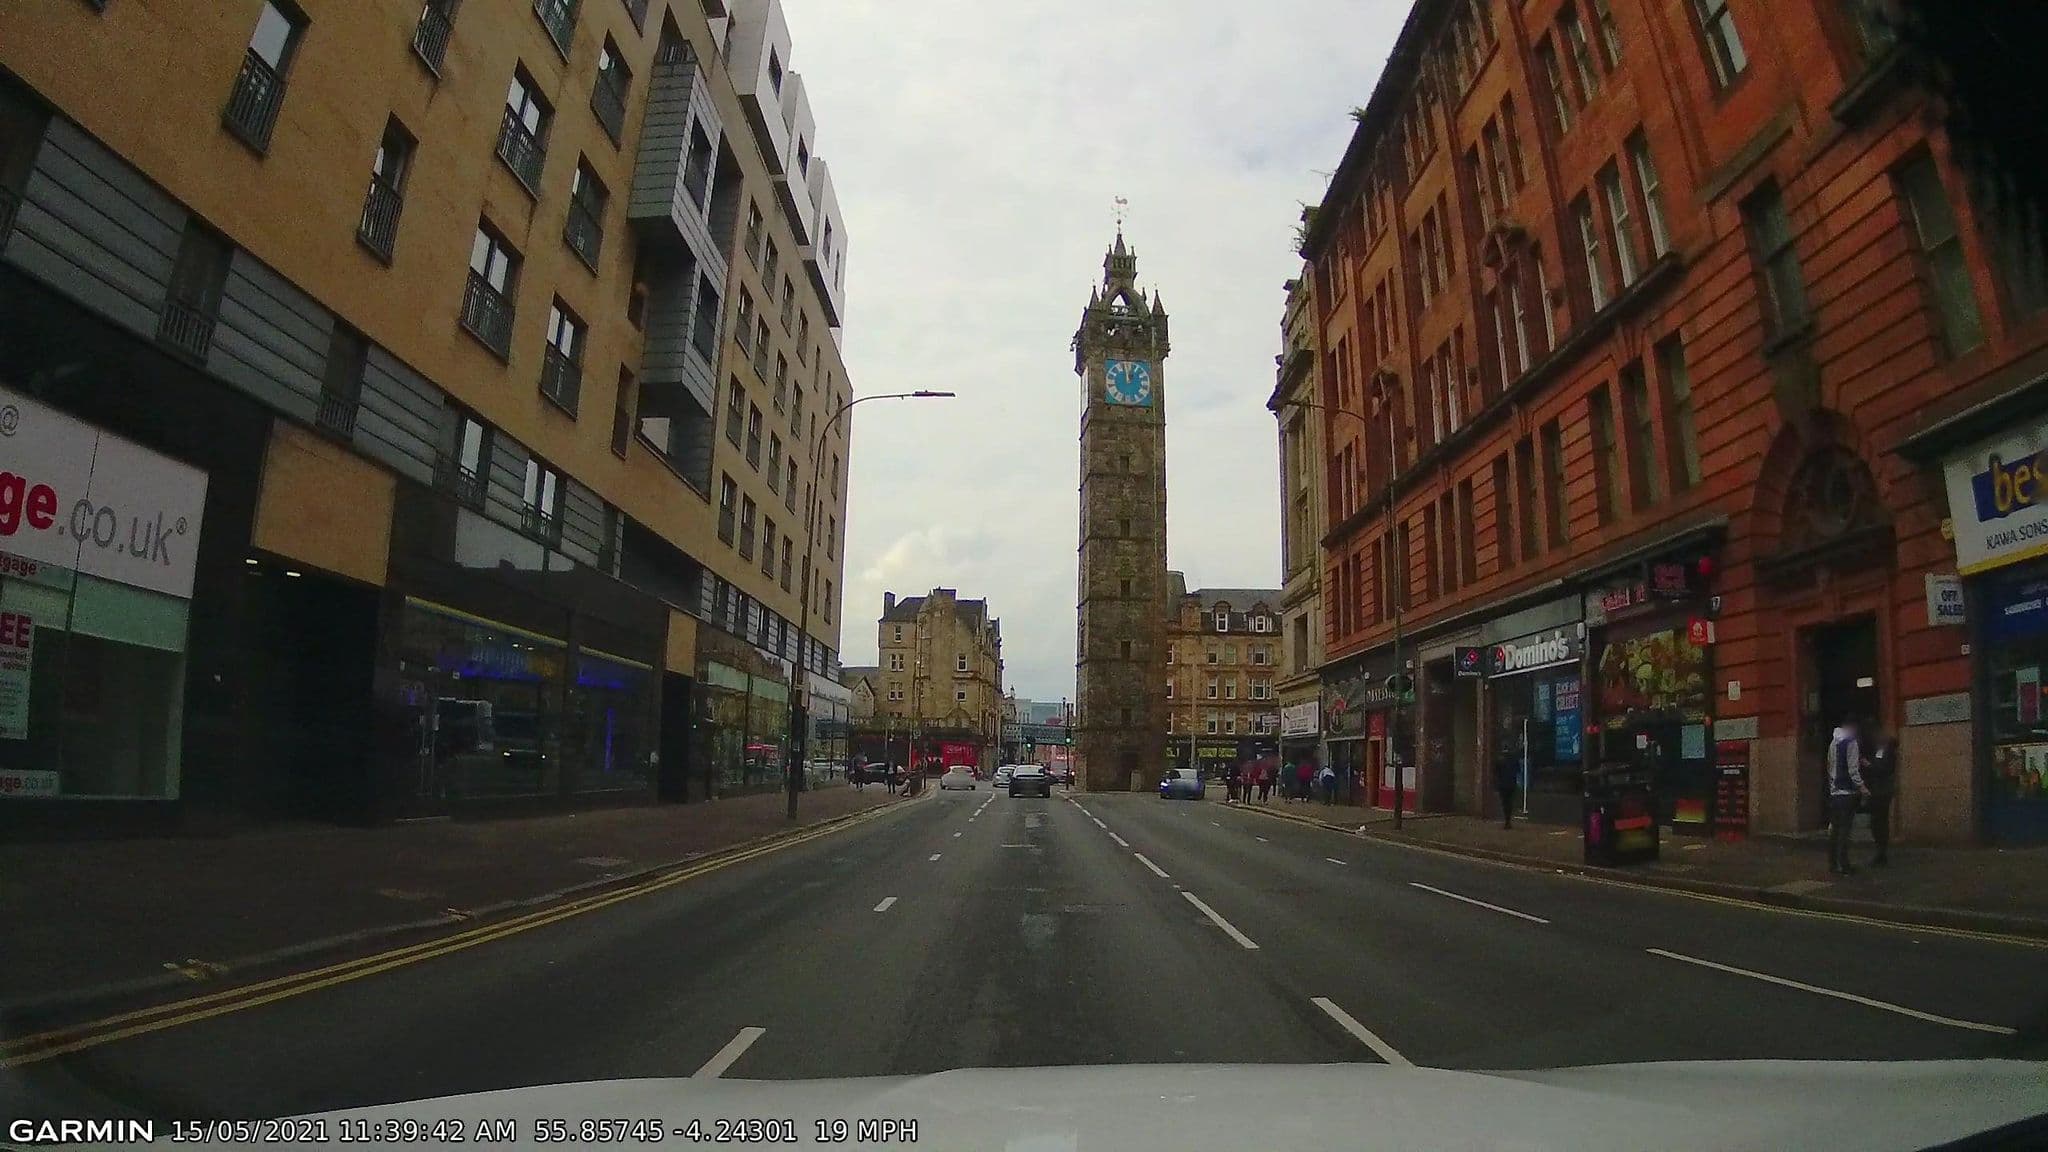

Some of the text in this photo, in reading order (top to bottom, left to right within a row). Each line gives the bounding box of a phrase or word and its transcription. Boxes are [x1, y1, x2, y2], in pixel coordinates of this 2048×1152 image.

[1986, 518, 2048, 549] KAWA SONS
[1505, 631, 1569, 671] Domino's
